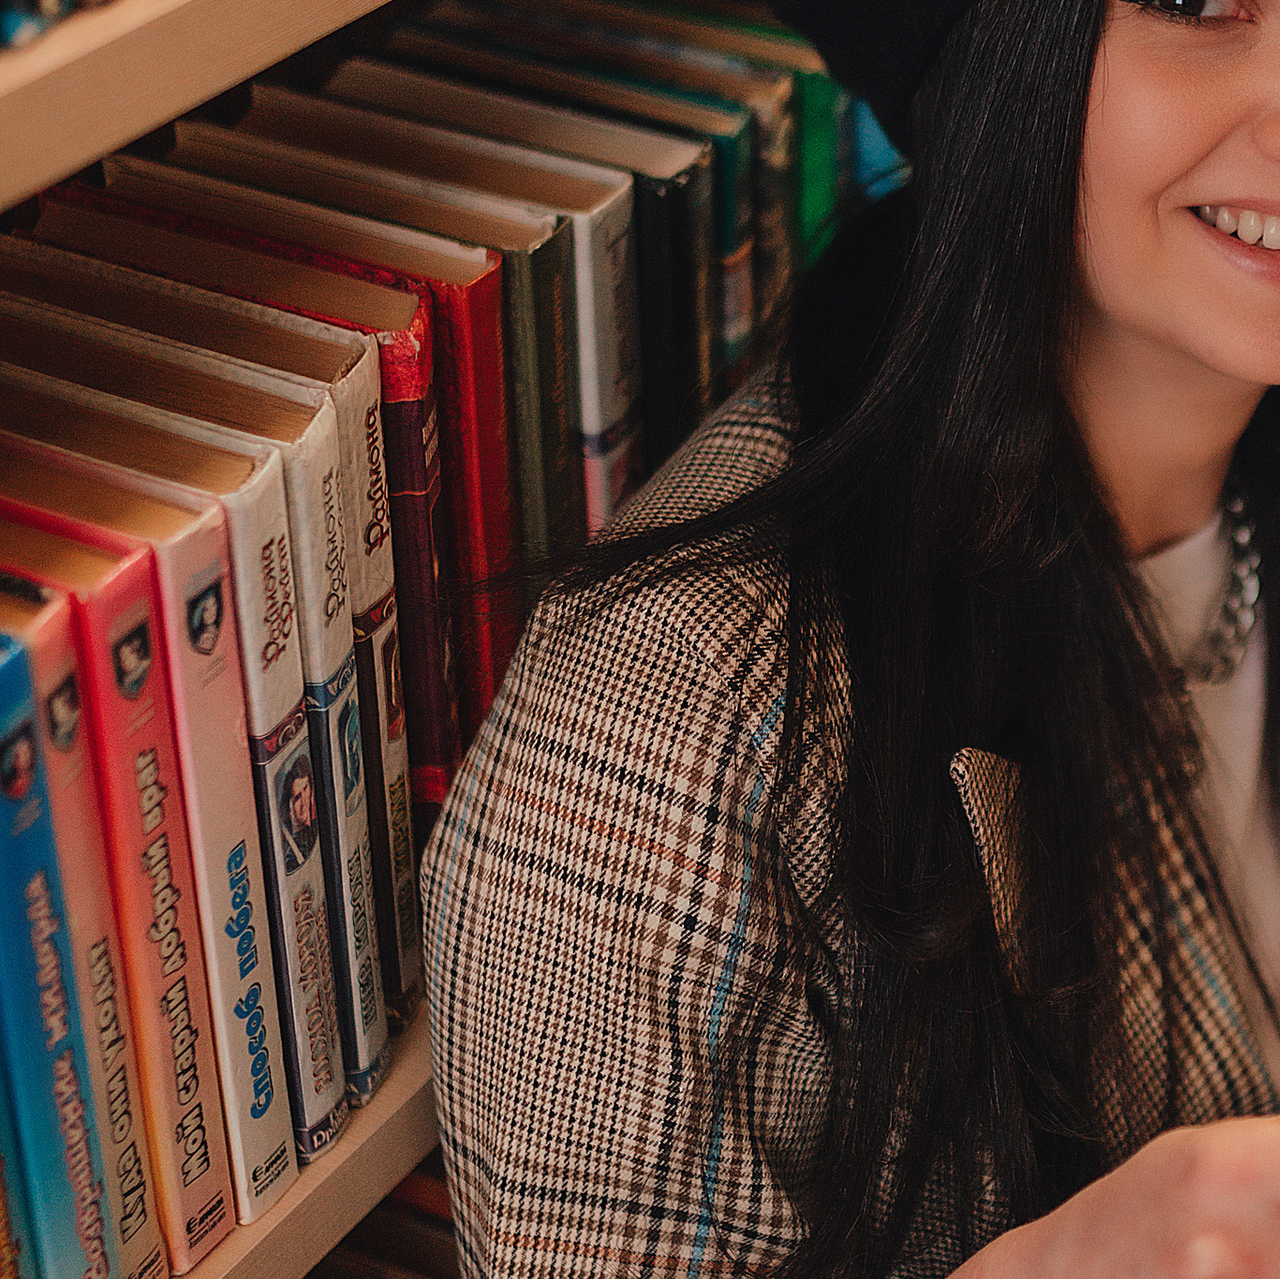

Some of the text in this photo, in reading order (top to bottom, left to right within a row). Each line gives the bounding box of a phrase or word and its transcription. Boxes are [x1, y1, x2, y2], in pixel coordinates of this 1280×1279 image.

[133, 746, 168, 833] враг
[140, 834, 188, 975] добрый
[223, 839, 258, 981] побега
[86, 935, 126, 1070] уходят
[158, 976, 202, 1100] старый
[232, 982, 274, 1120] Способ
[302, 988, 334, 1097] ВОСХОД
[104, 1064, 134, 1145] они
[172, 1102, 211, 1188] Мой
[116, 1140, 147, 1245] Куда
